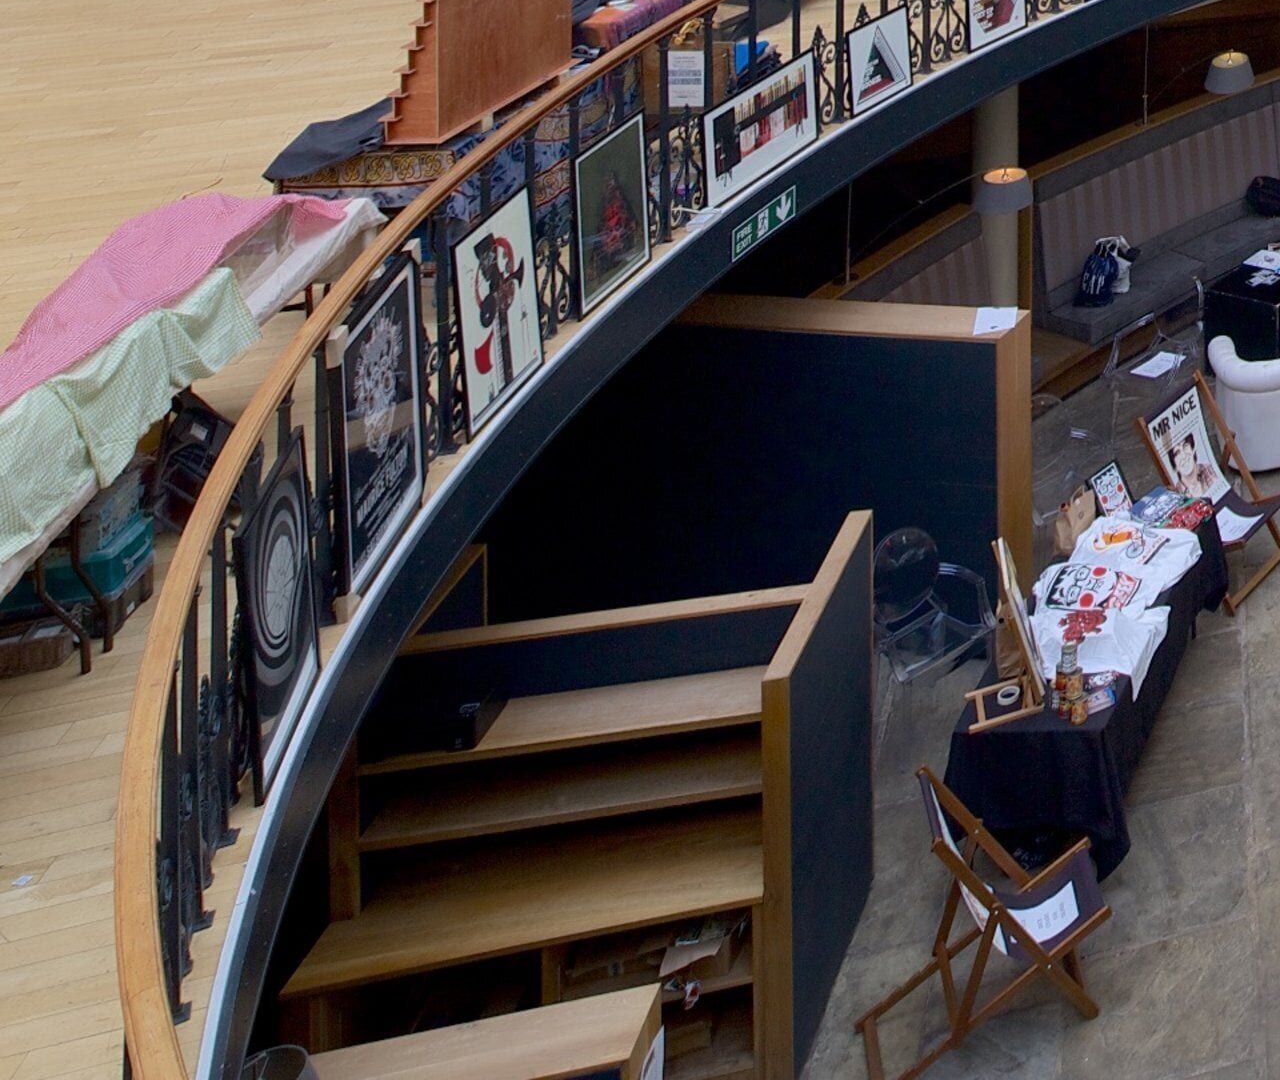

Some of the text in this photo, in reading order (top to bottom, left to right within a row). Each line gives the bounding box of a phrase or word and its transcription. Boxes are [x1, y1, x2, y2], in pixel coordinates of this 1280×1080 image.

[736, 223, 753, 242] FIRE
[735, 233, 753, 253] EXIT
[1152, 417, 1171, 441] MR
[1172, 394, 1197, 425] NICE
